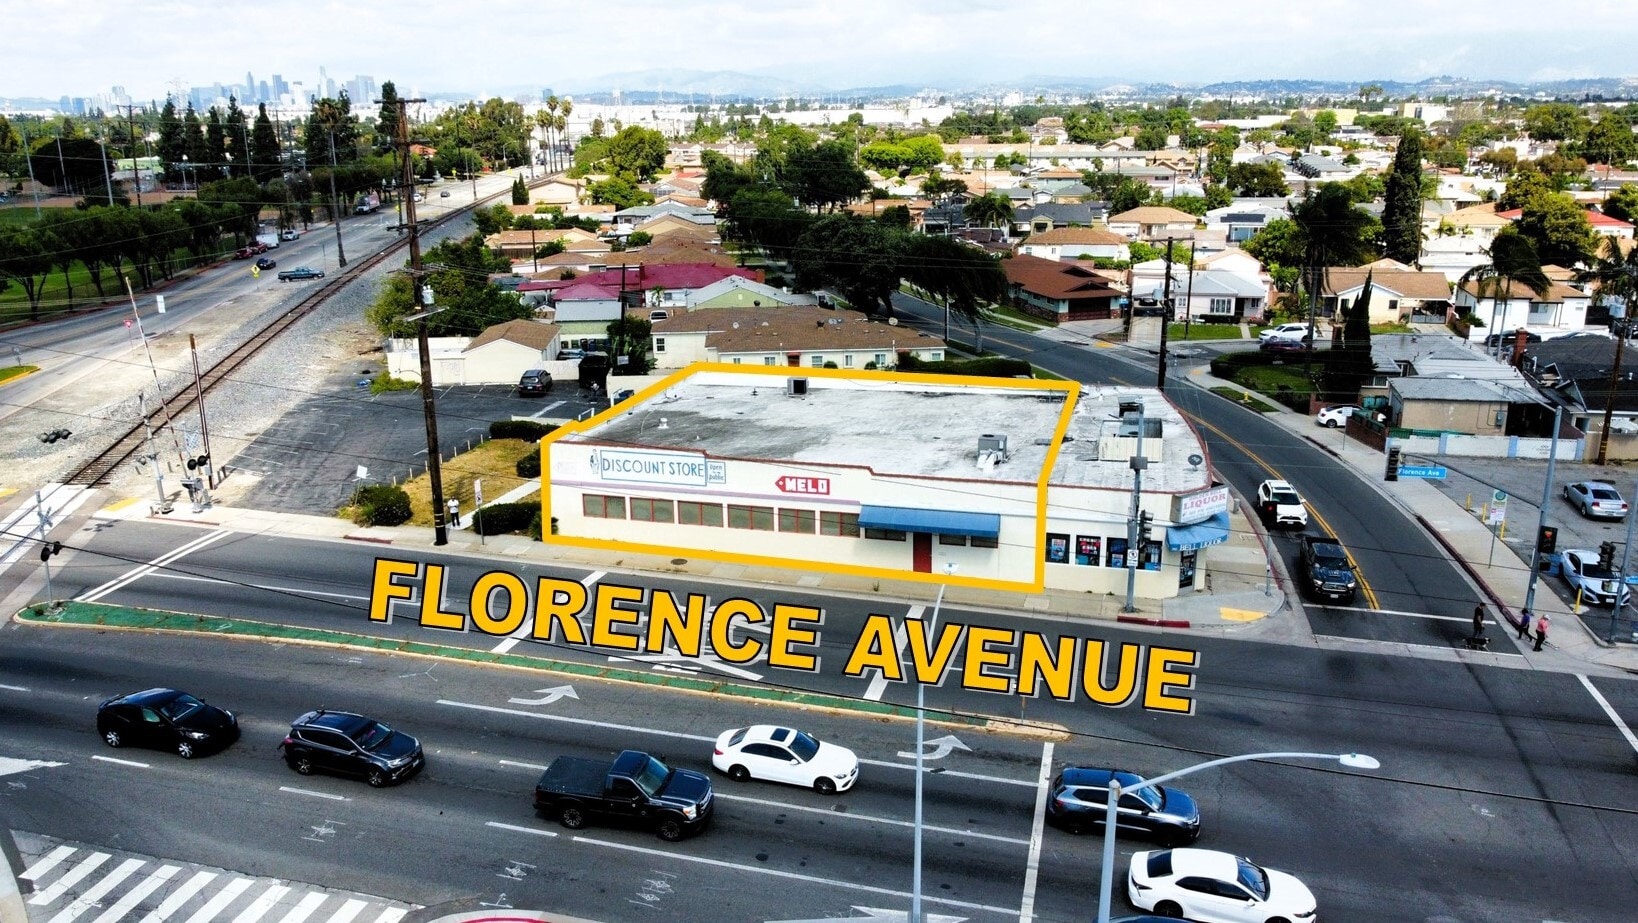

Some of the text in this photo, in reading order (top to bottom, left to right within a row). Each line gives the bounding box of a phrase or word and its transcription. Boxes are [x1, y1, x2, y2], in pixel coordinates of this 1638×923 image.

[602, 457, 704, 477] DISCOUNT STORE
[1398, 468, 1426, 476] Florence
[1183, 493, 1226, 509] LIQUOR
